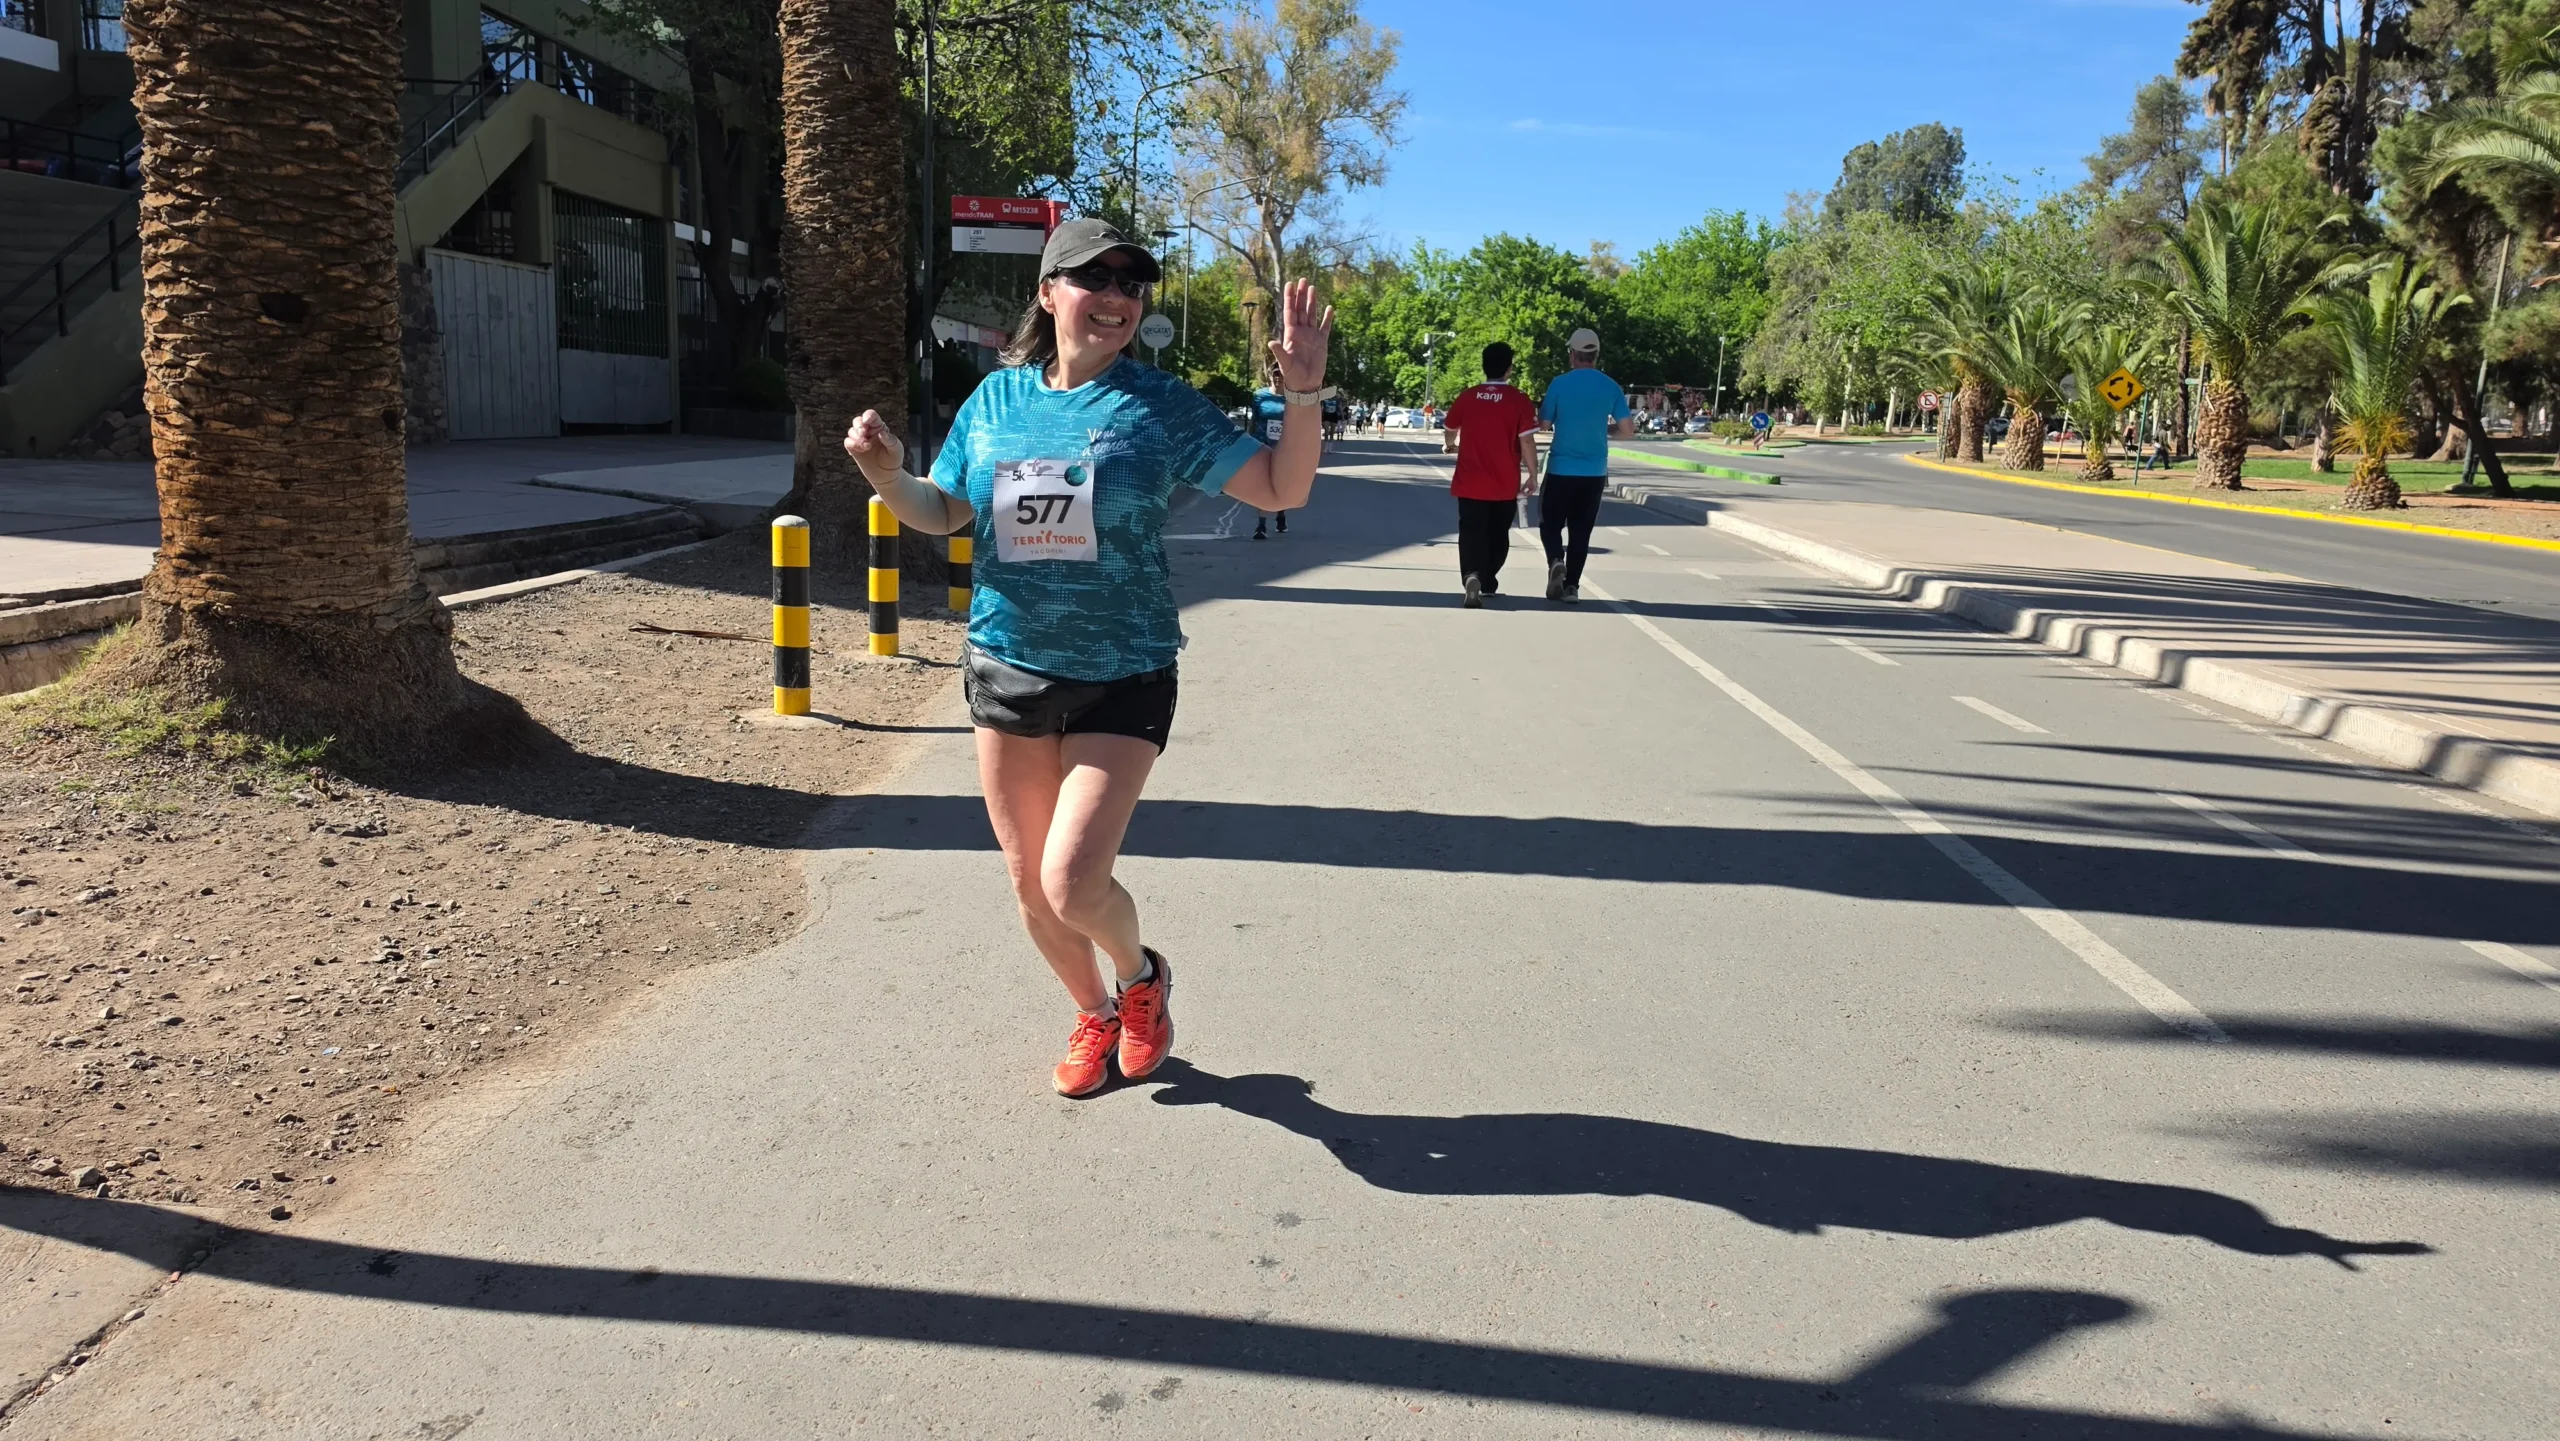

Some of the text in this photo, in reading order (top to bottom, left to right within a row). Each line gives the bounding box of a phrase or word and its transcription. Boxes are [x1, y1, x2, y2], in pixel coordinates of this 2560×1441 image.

[1143, 327, 1171, 337] REGATAS
[1012, 470, 1025, 481] 5k
[1016, 495, 1075, 525] 577
